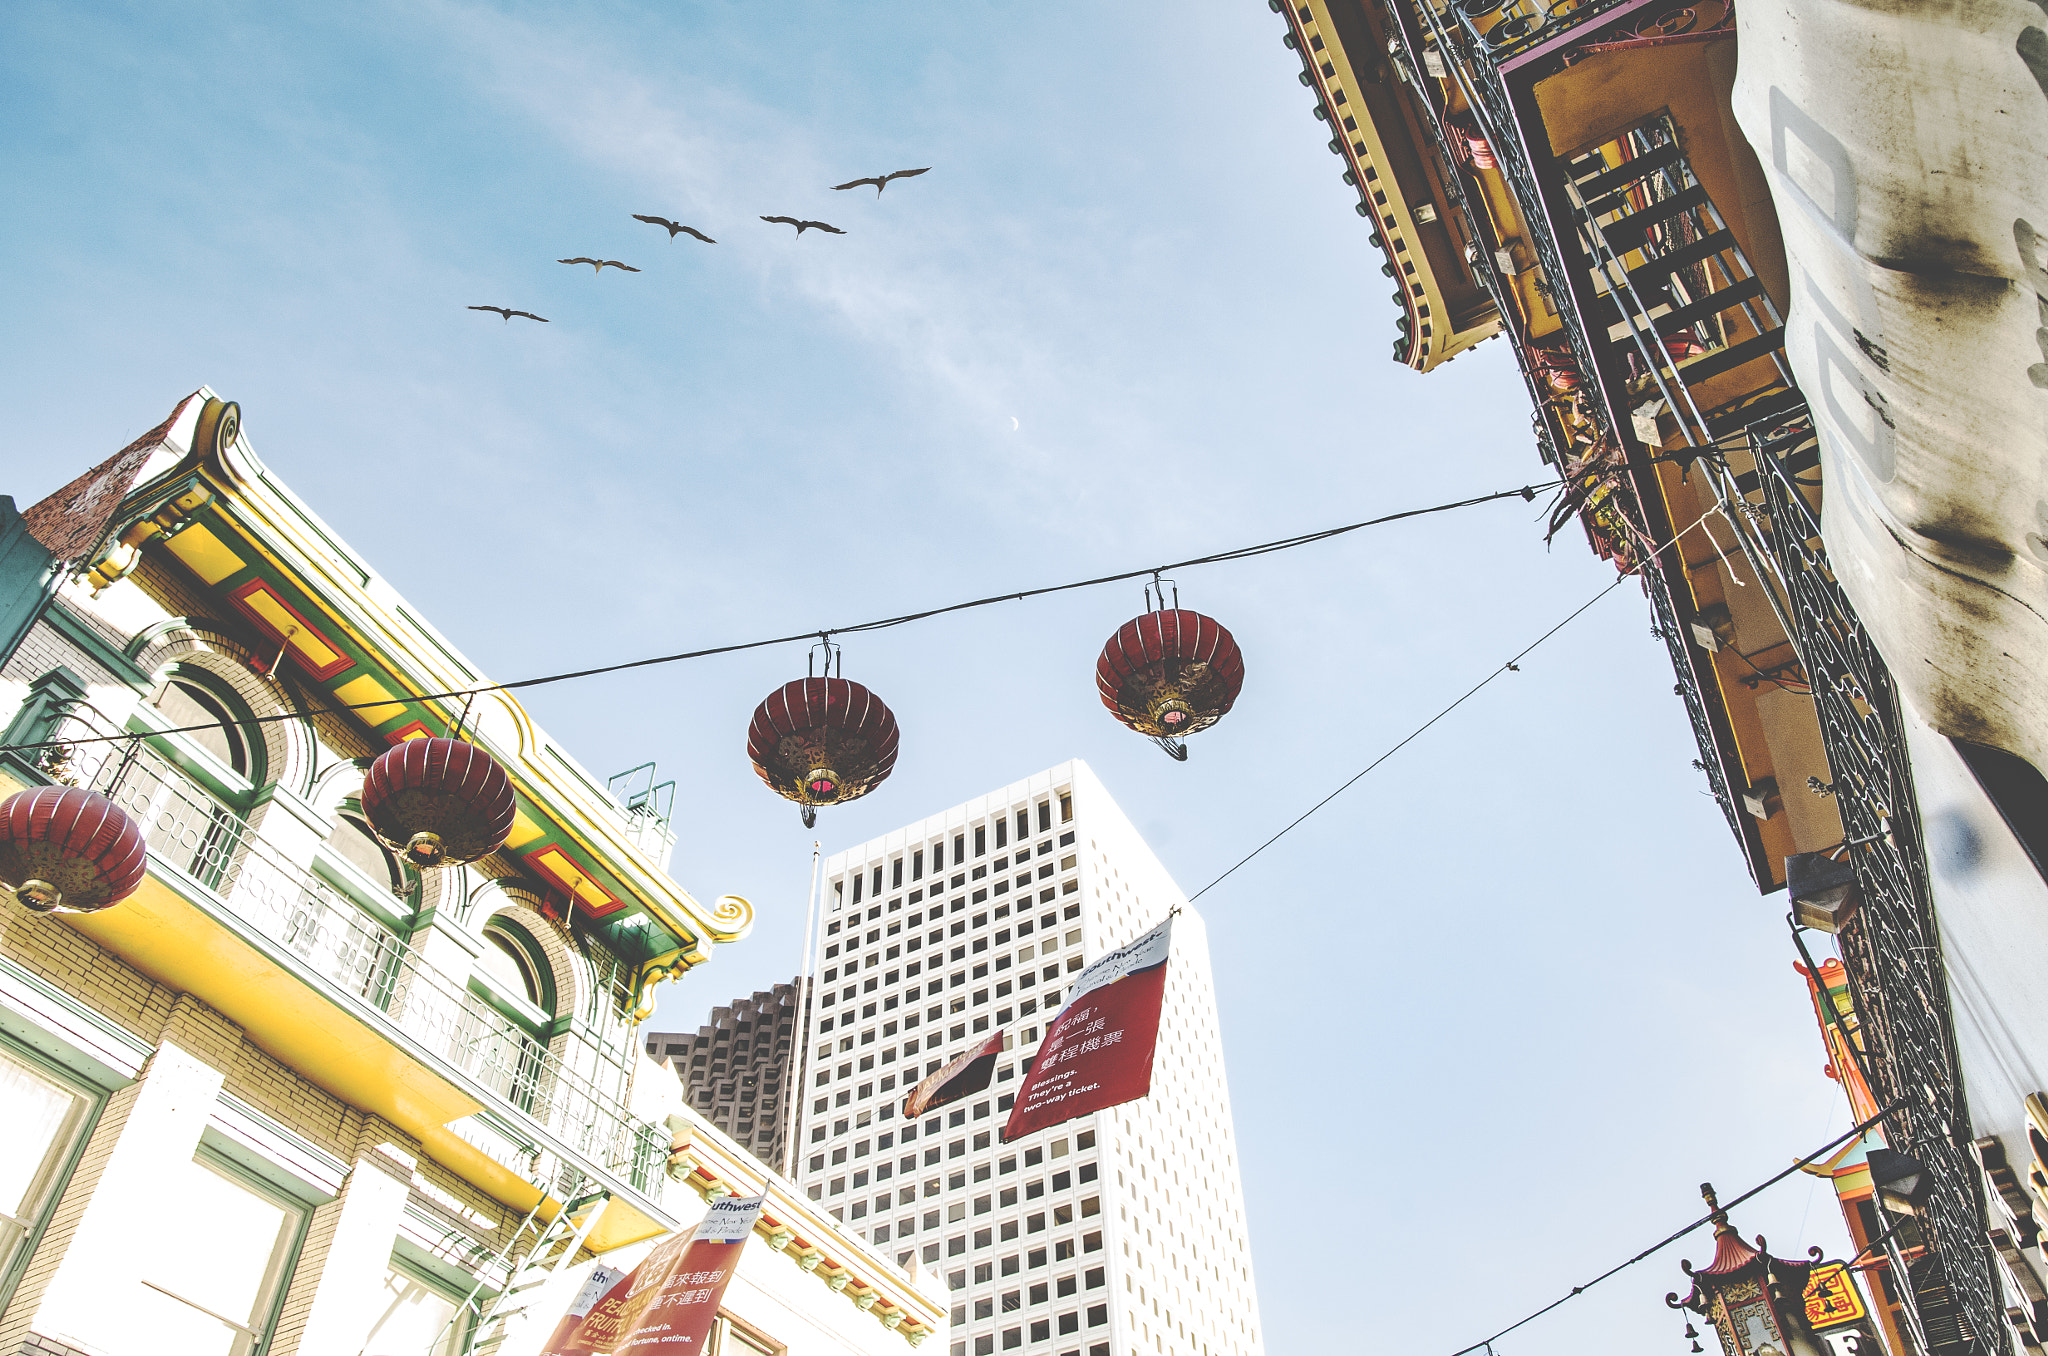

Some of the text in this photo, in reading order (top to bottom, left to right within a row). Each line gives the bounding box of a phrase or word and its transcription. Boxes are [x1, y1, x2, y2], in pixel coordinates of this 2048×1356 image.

[1038, 1029, 1125, 1075] 雙程機票
[1031, 1069, 1078, 1091] Blessings.
[1023, 1082, 1101, 1113] two-way ticket.
[1027, 1083, 1064, 1102] They're
[711, 1200, 761, 1211] uthwest
